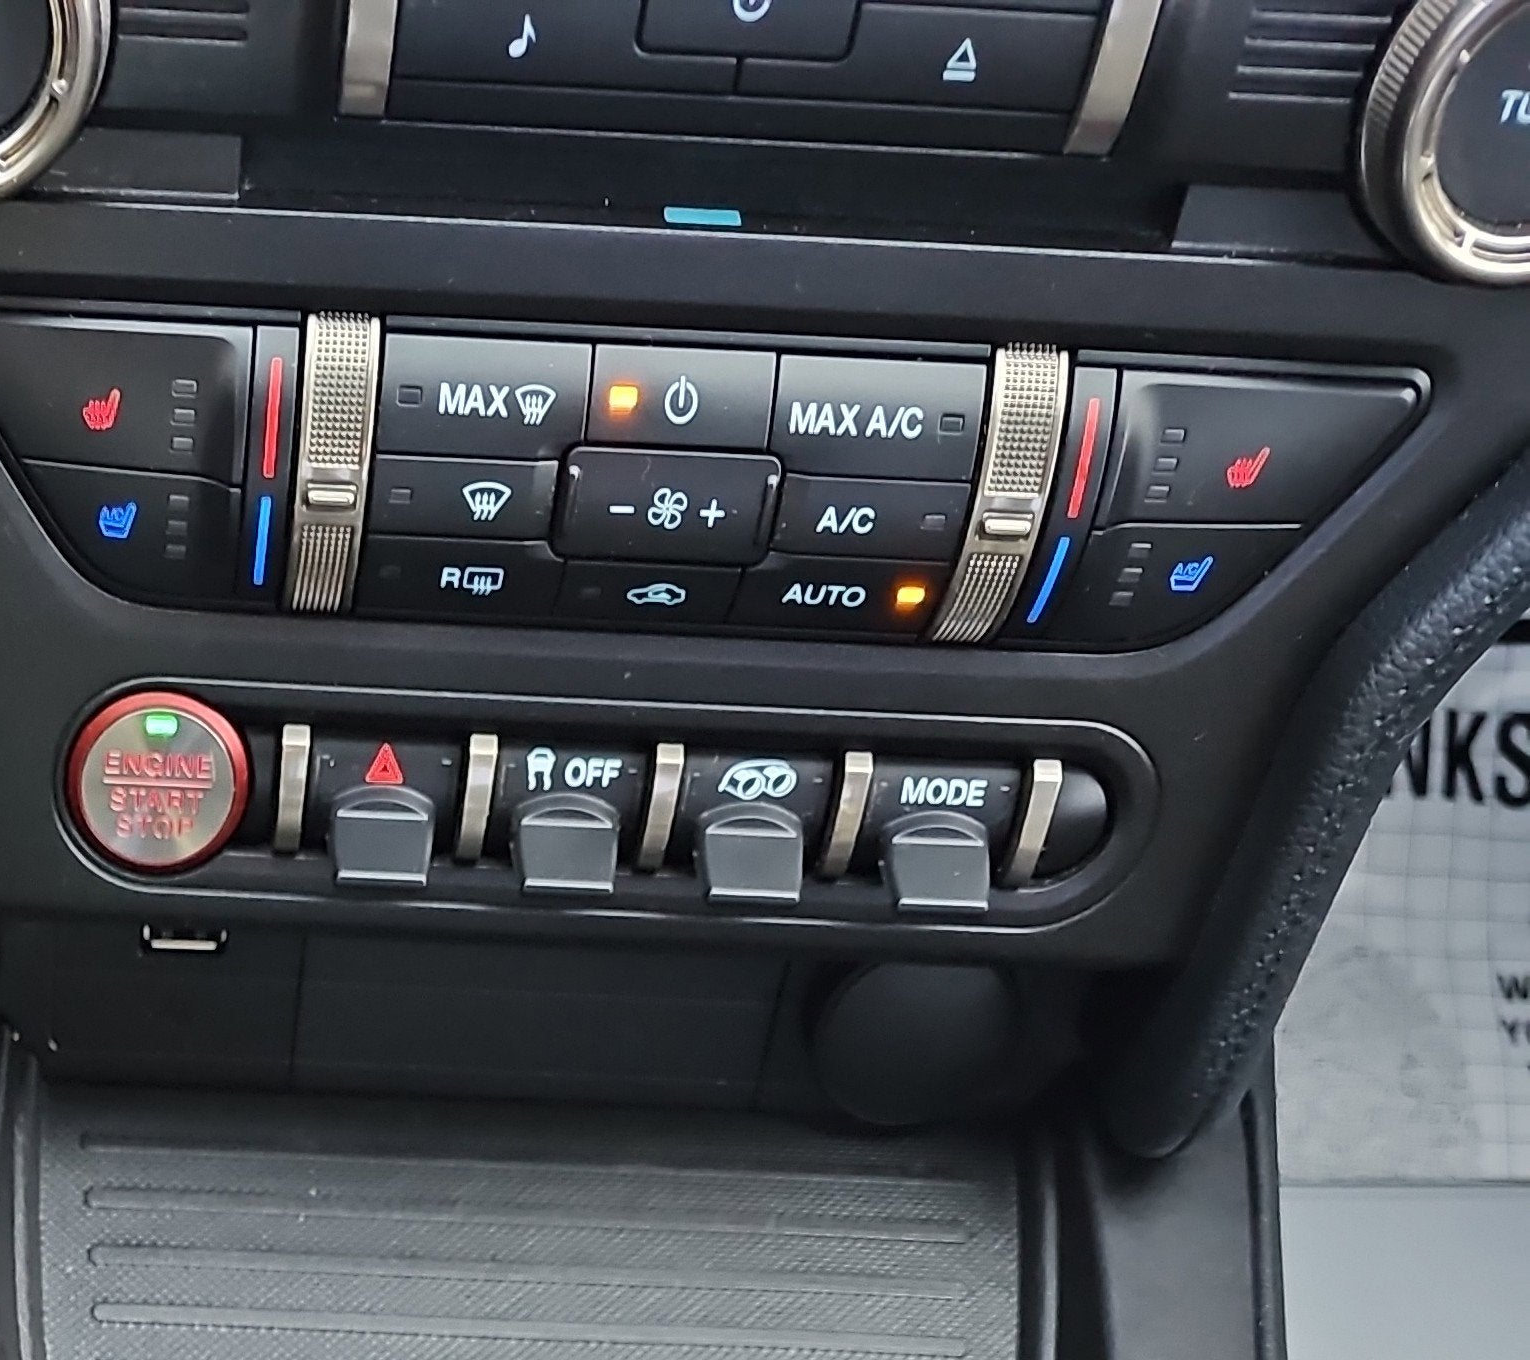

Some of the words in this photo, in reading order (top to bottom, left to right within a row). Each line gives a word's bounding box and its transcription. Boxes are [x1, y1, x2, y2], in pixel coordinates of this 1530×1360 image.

[438, 382, 510, 418] MAX
[789, 401, 861, 436] MAX
[865, 405, 924, 439] A/C
[815, 505, 876, 534] A/C
[440, 566, 462, 589] R
[781, 583, 867, 608] AUTO
[104, 749, 214, 779] ENGINE
[564, 757, 623, 788] OFF
[110, 787, 205, 814] START
[900, 776, 988, 808] MODE
[115, 813, 194, 839] STOP
